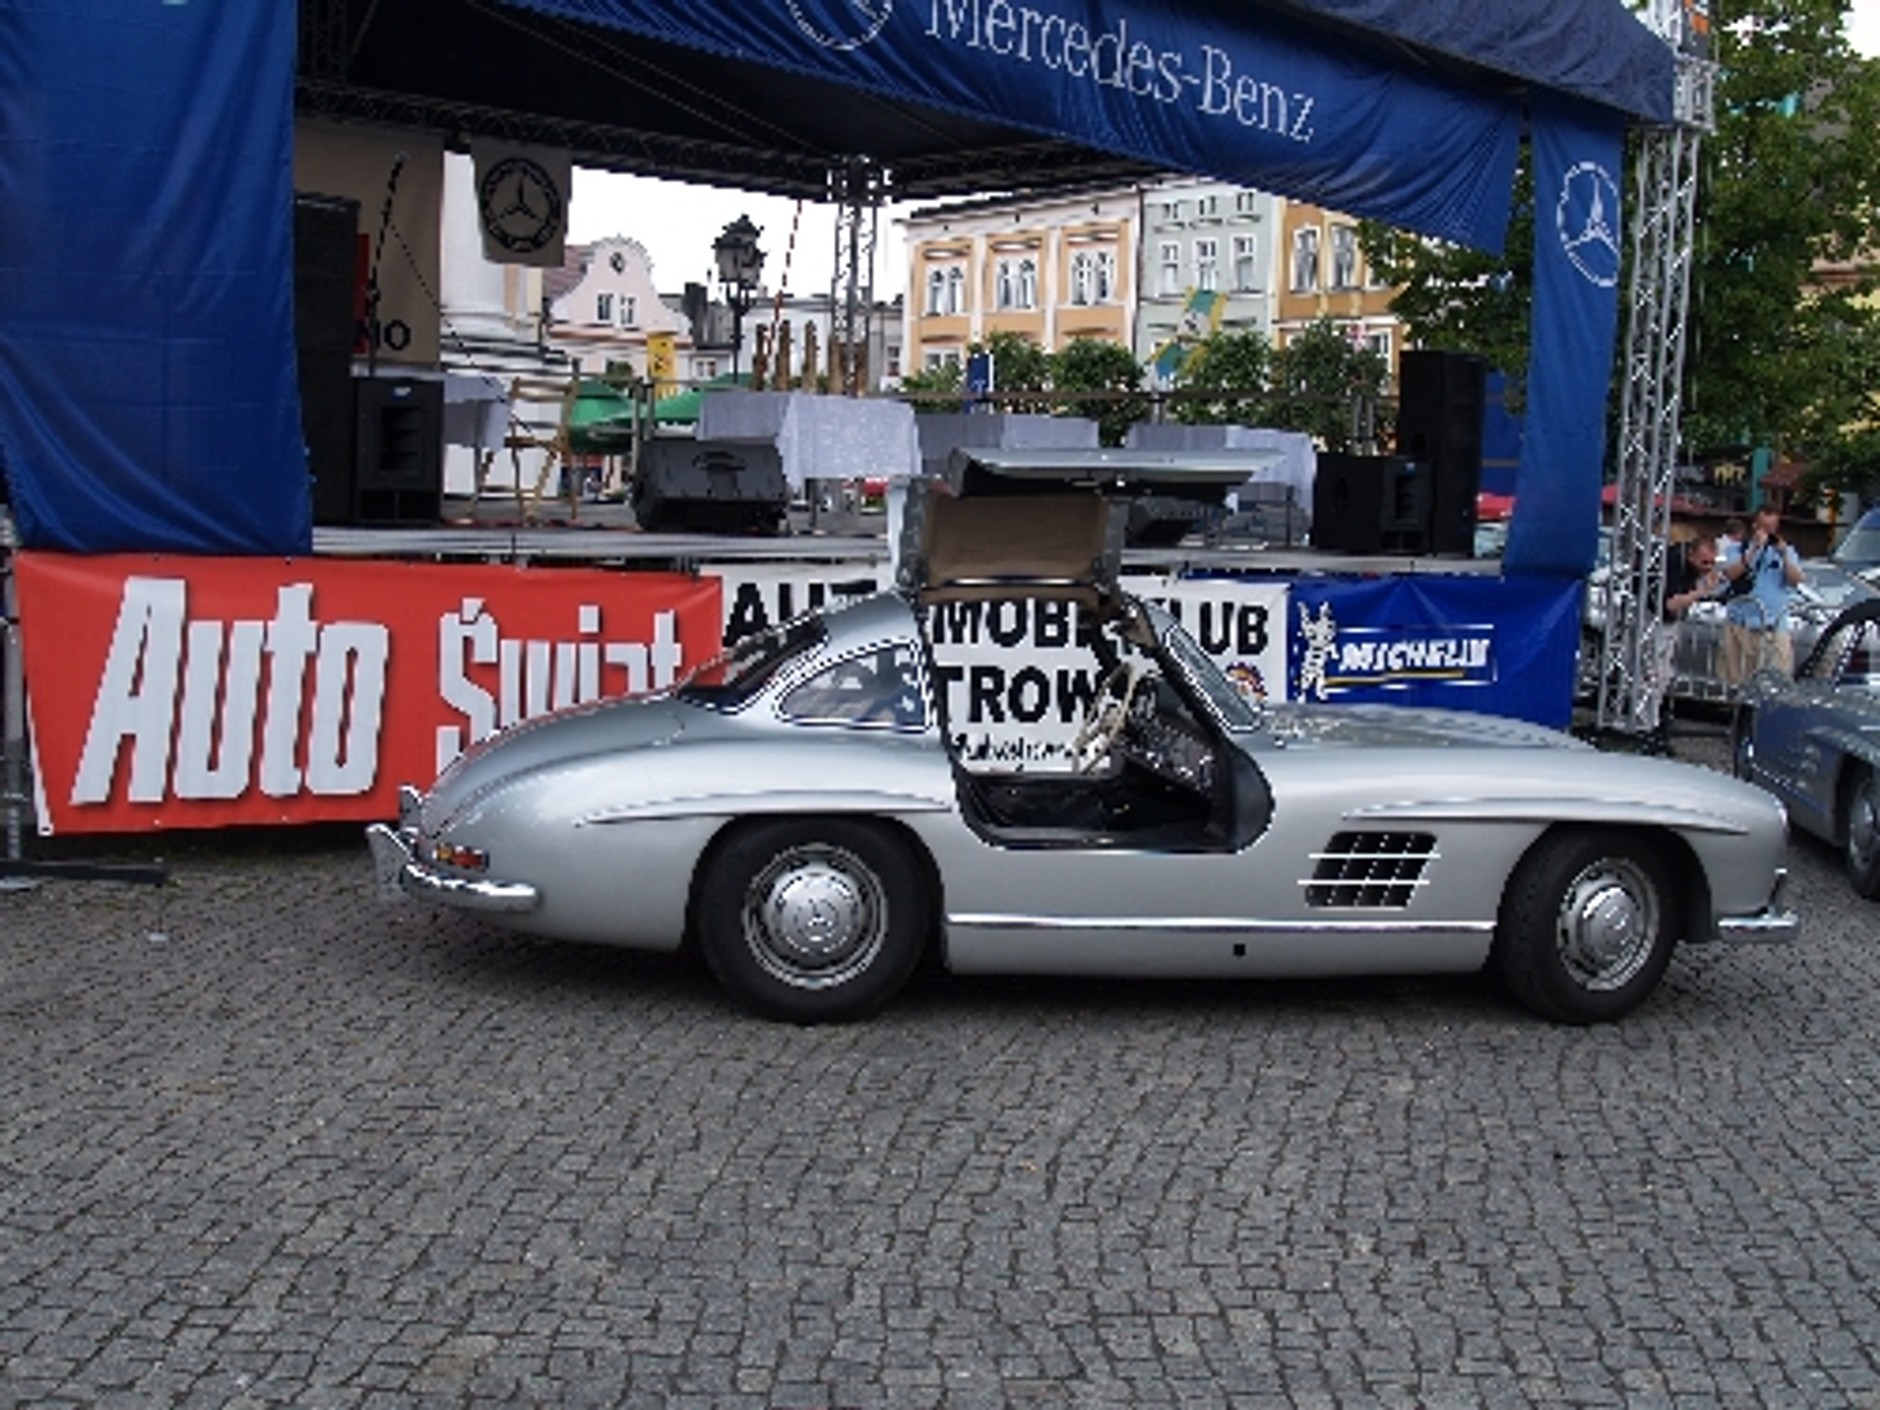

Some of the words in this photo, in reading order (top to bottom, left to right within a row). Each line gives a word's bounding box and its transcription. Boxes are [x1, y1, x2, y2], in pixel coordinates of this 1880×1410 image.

[925, 0, 1314, 143] Mercedes-Benz
[69, 576, 390, 804] Auto
[1339, 638, 1490, 672] MICHELIN
